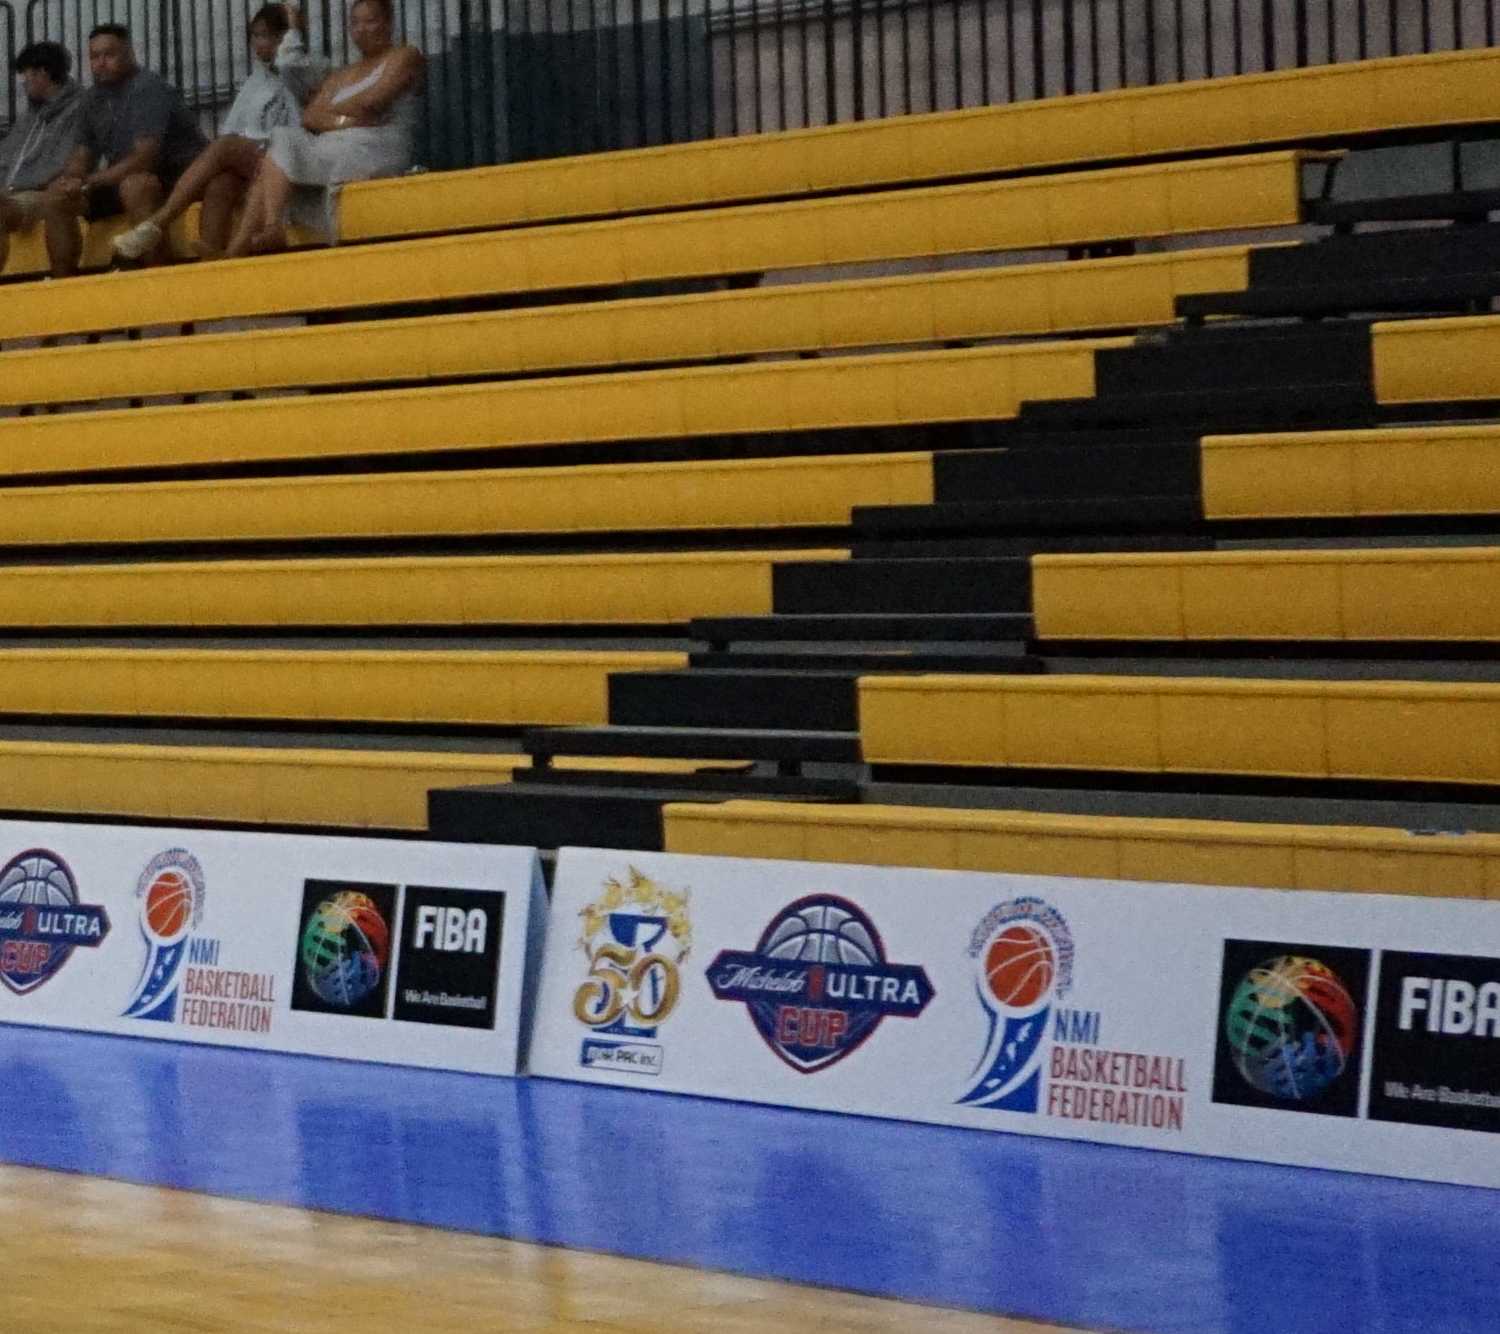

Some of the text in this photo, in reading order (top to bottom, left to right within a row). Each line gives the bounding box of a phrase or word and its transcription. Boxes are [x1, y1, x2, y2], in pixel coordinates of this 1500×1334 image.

[37, 913, 102, 937] ULTRA
[412, 904, 489, 954] FIBA
[1, 938, 51, 975] CUP
[189, 937, 221, 966] NMI
[184, 967, 276, 1003] BASKETBALL
[572, 942, 681, 1027] 50
[716, 963, 921, 1005] Michelob ULTRA
[180, 998, 272, 1034] FEDERATION
[776, 1004, 848, 1048] CUP
[1054, 1008, 1101, 1045] NMI
[1398, 975, 1500, 1039] FIBA
[1050, 1045, 1188, 1093] BASKETBALL
[1046, 1082, 1185, 1131] FEDERATION
